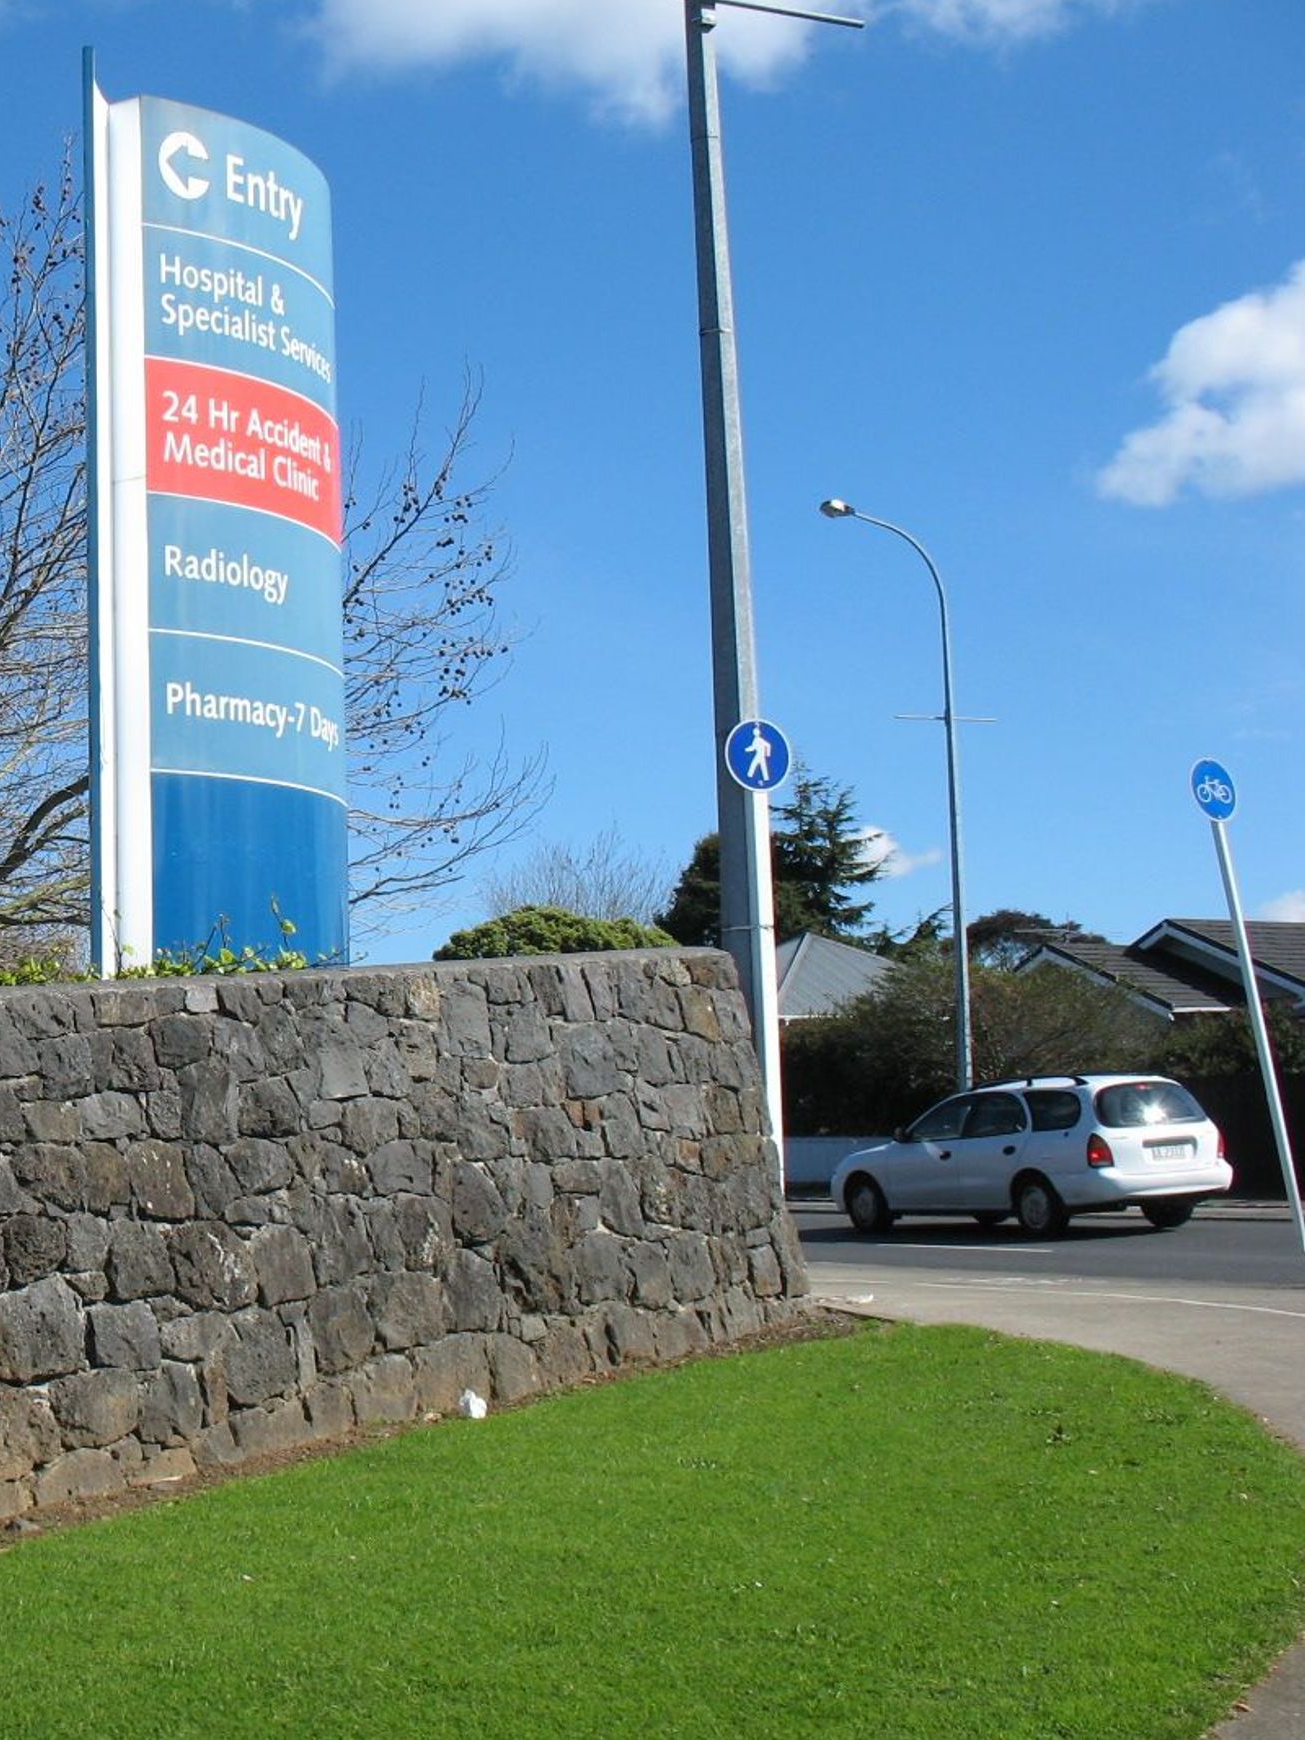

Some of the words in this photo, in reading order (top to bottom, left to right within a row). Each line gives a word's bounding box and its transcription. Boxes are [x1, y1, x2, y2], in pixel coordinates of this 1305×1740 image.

[225, 153, 304, 241] Entry
[159, 253, 263, 308] Hospital
[270, 283, 285, 317] &
[160, 293, 276, 351] Specialist
[280, 325, 331, 384] Services
[162, 390, 199, 426] 24
[209, 398, 241, 434] Hr
[246, 409, 321, 468] Accident
[163, 431, 267, 481] Medical
[272, 455, 321, 502] Clinic
[163, 545, 288, 605] Radiology
[310, 706, 340, 752] Days
